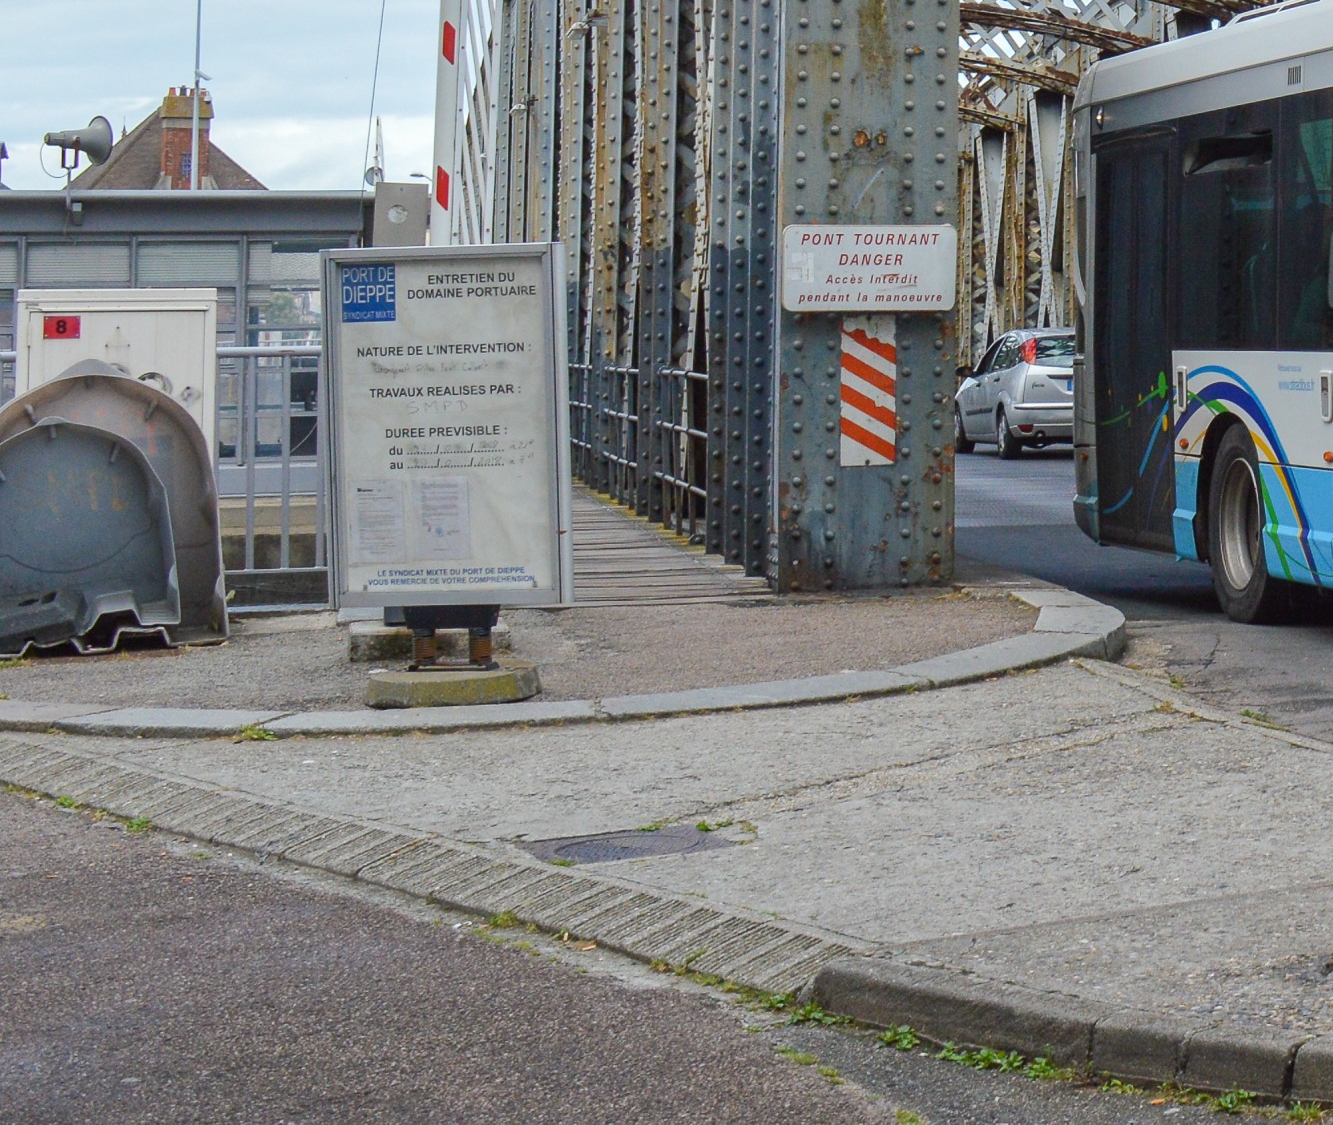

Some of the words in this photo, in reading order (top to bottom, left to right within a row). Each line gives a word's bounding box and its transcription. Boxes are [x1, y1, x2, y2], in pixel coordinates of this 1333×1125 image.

[801, 233, 845, 245] PONT
[854, 233, 940, 245] TOURNANT
[839, 253, 904, 266] DANGER
[343, 267, 374, 283] PORT
[378, 266, 395, 282] DE
[428, 273, 495, 285] ENTRETIEN
[498, 272, 515, 283] DU
[826, 274, 863, 284] Accès
[870, 273, 918, 284] Interdit
[342, 284, 395, 304] DIEPPE
[407, 288, 463, 300] DOMAINE
[467, 285, 537, 298] PORTUAIRE
[799, 293, 850, 304] pendant
[857, 293, 868, 302] la
[875, 294, 943, 303] manoeuvre
[55, 319, 67, 334] 8
[357, 346, 404, 358] NATURE
[407, 345, 423, 356] DE
[427, 342, 525, 356] L'INTERVENTION
[370, 386, 424, 398] TRAVAUX
[427, 385, 486, 397] REALISES
[489, 383, 515, 395] PAR
[385, 427, 425, 439] DUREE
[429, 425, 500, 437] PREVISIBLE
[389, 445, 404, 456] du
[390, 462, 404, 470] au
[377, 569, 387, 577] LE
[388, 569, 424, 577] SYNDICAT
[426, 568, 448, 576] MIXTE
[450, 568, 461, 576] DU
[463, 567, 482, 575] PORT
[485, 567, 496, 575] DE
[497, 566, 526, 574] DIEPPE
[390, 578, 428, 586] REMERCIE
[429, 577, 440, 585] DE
[442, 576, 467, 584] VOTRE
[469, 575, 536, 584] COMPREHENSION
